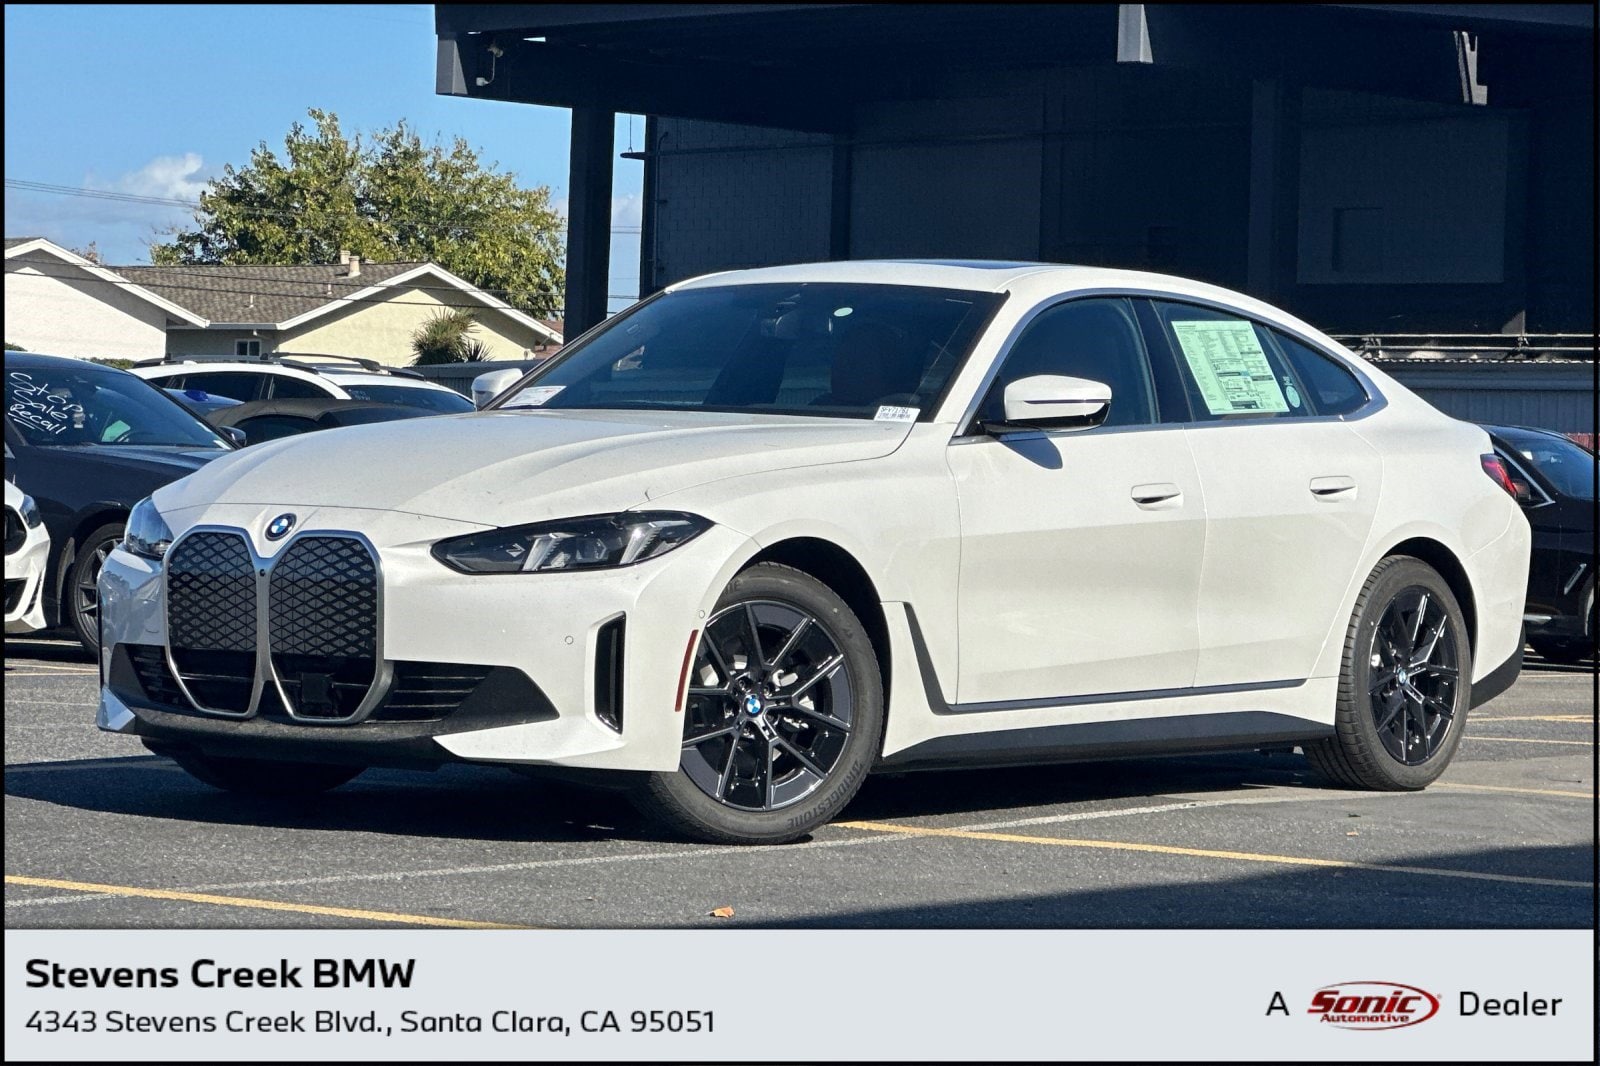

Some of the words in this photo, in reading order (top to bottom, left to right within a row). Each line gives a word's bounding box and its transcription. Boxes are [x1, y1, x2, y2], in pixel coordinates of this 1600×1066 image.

[9, 372, 83, 412] Stop
[12, 389, 68, 421] Sale
[10, 403, 66, 434] Recall
[787, 760, 864, 829] BRIDGESTONE
